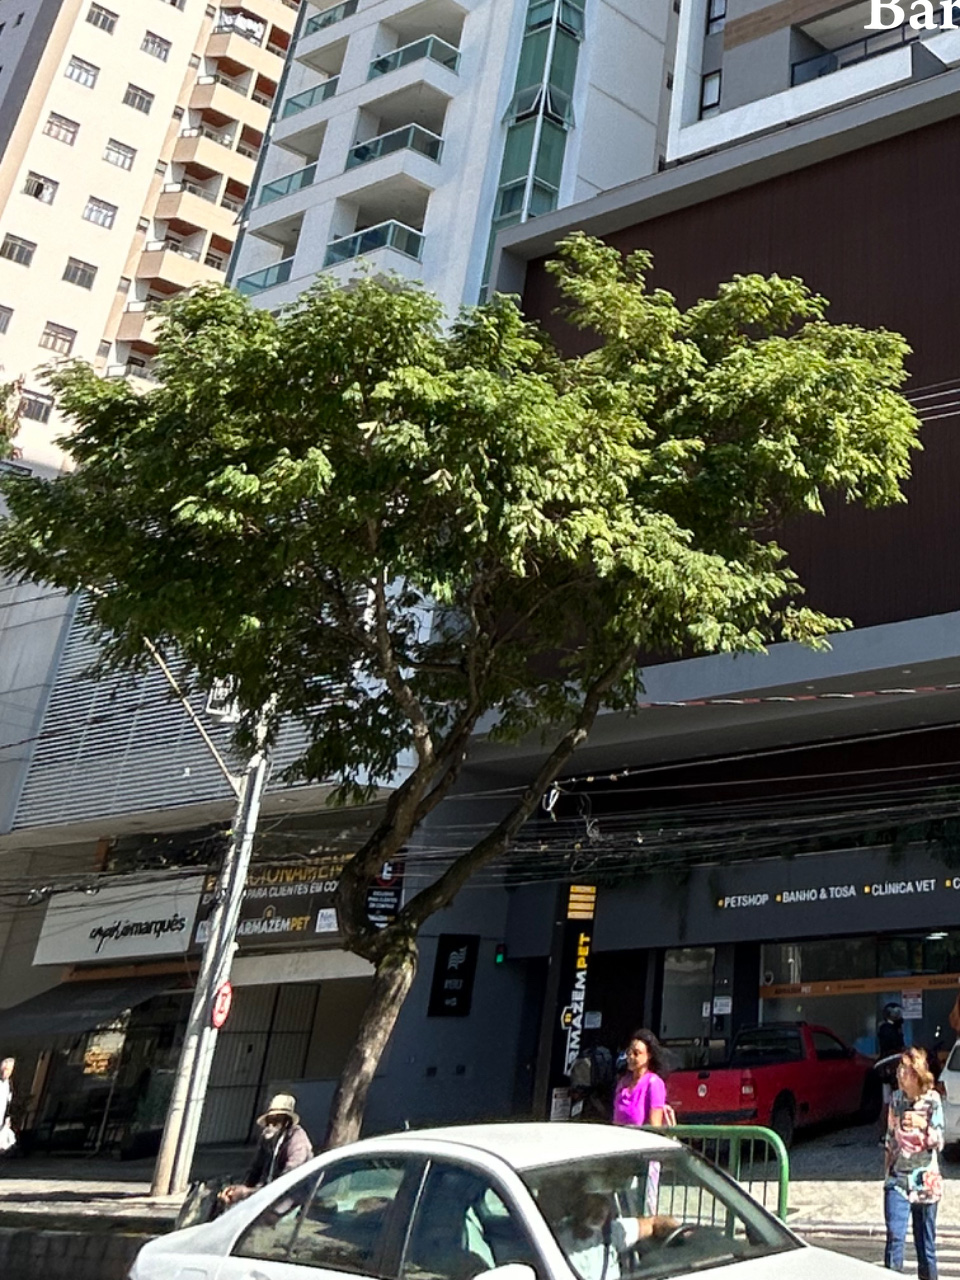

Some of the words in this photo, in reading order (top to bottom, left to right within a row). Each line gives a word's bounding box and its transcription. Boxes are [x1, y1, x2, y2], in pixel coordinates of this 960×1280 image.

[724, 893, 769, 908] PETSHOP
[782, 889, 818, 903] BANHO
[819, 887, 828, 900] &
[828, 884, 857, 898] TOSA
[871, 880, 914, 896] CLÍNICA
[915, 879, 937, 892] VET
